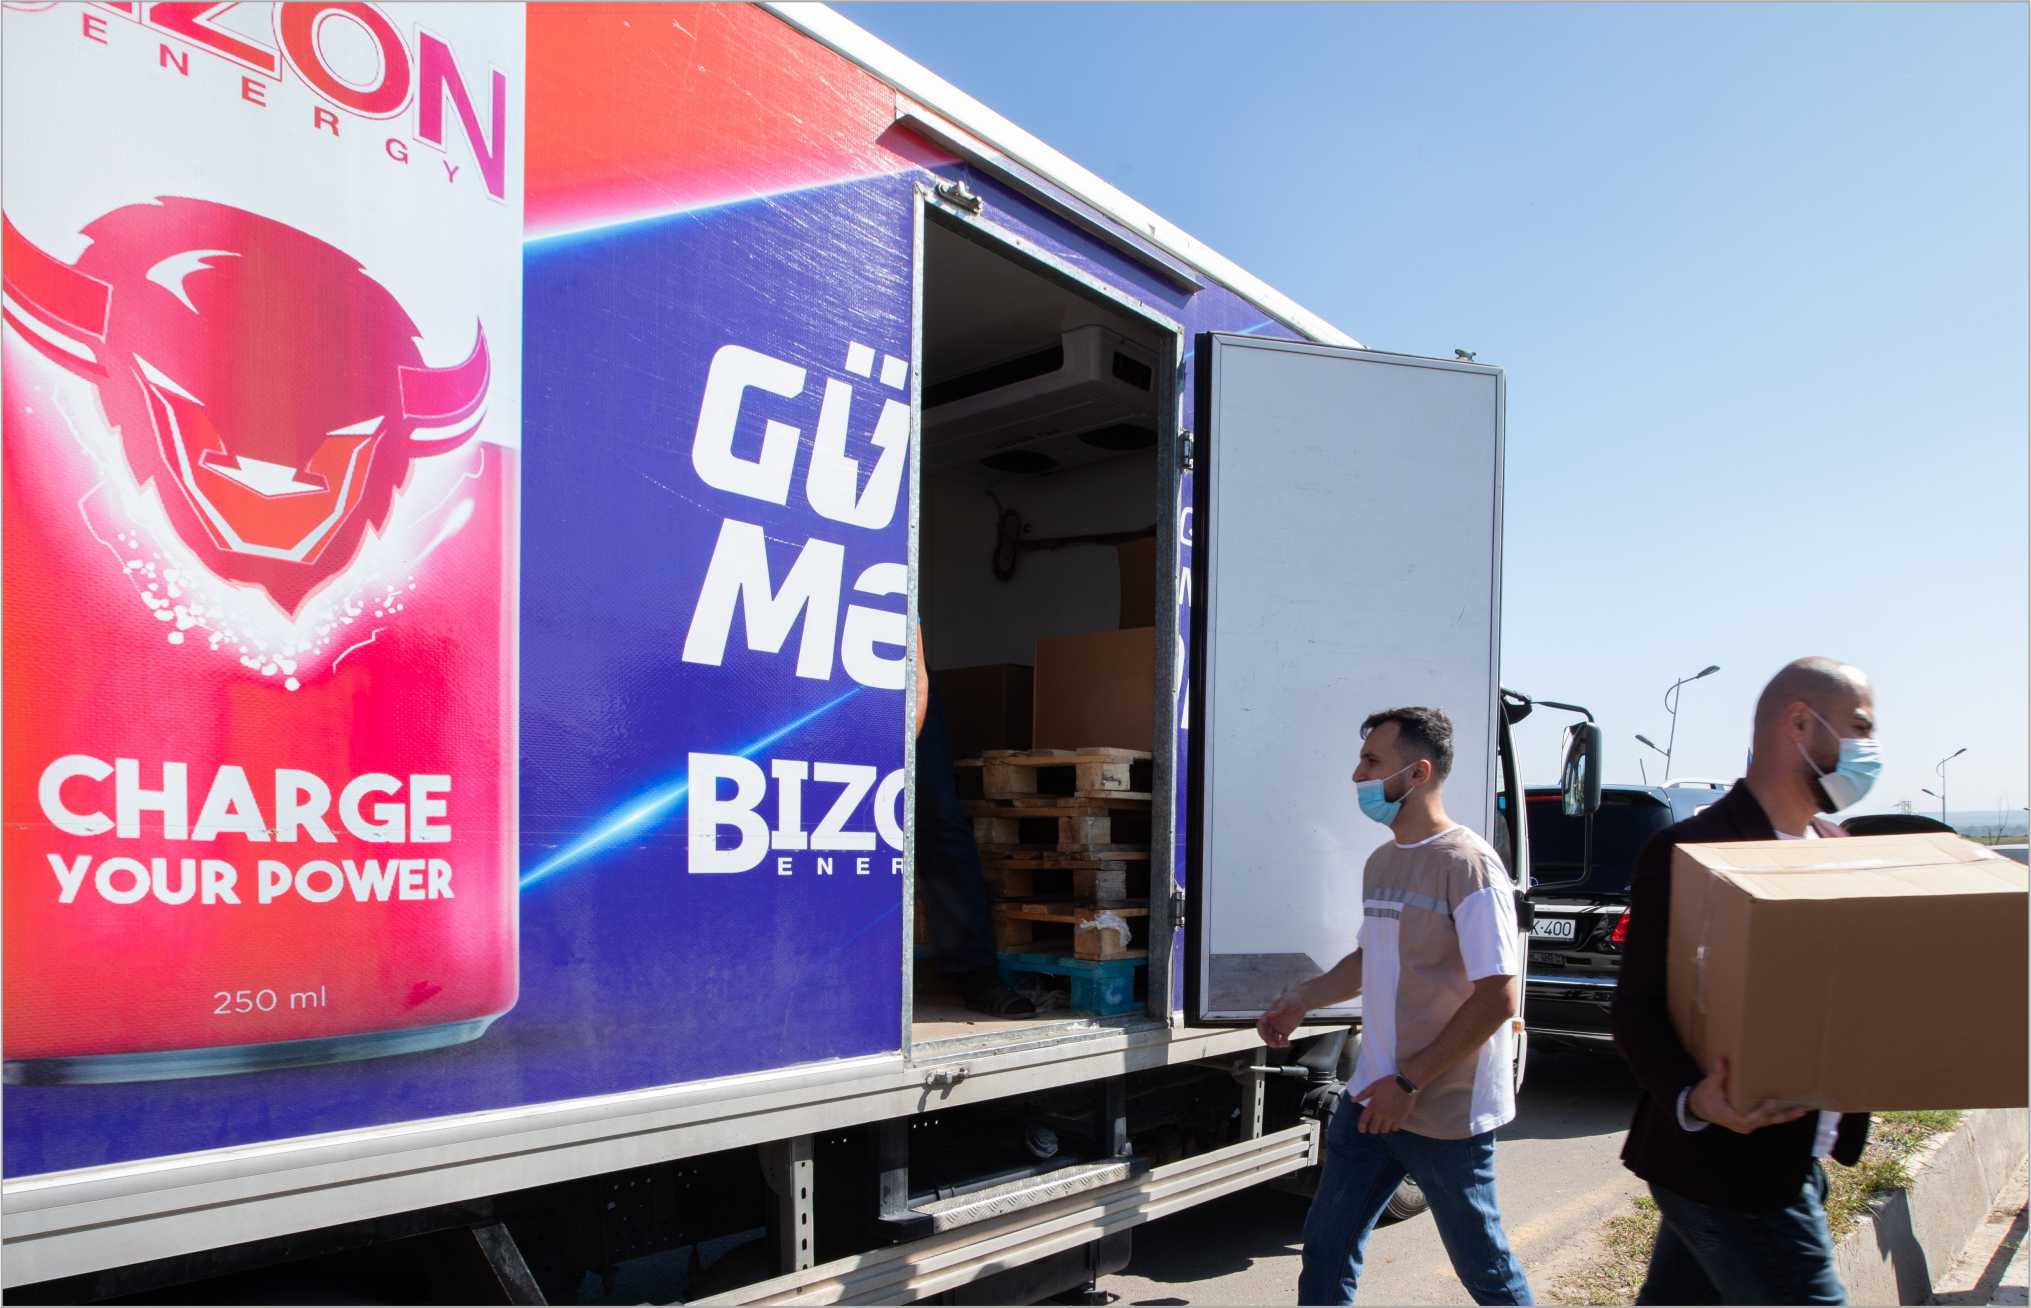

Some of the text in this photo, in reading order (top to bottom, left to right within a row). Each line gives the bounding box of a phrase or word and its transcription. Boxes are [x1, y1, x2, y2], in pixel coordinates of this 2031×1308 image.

[82, 12, 459, 183] ENERGY
[38, 754, 452, 843] CHARGE
[47, 854, 455, 905] YOUR POWER
[213, 985, 327, 1014] 250 ml
